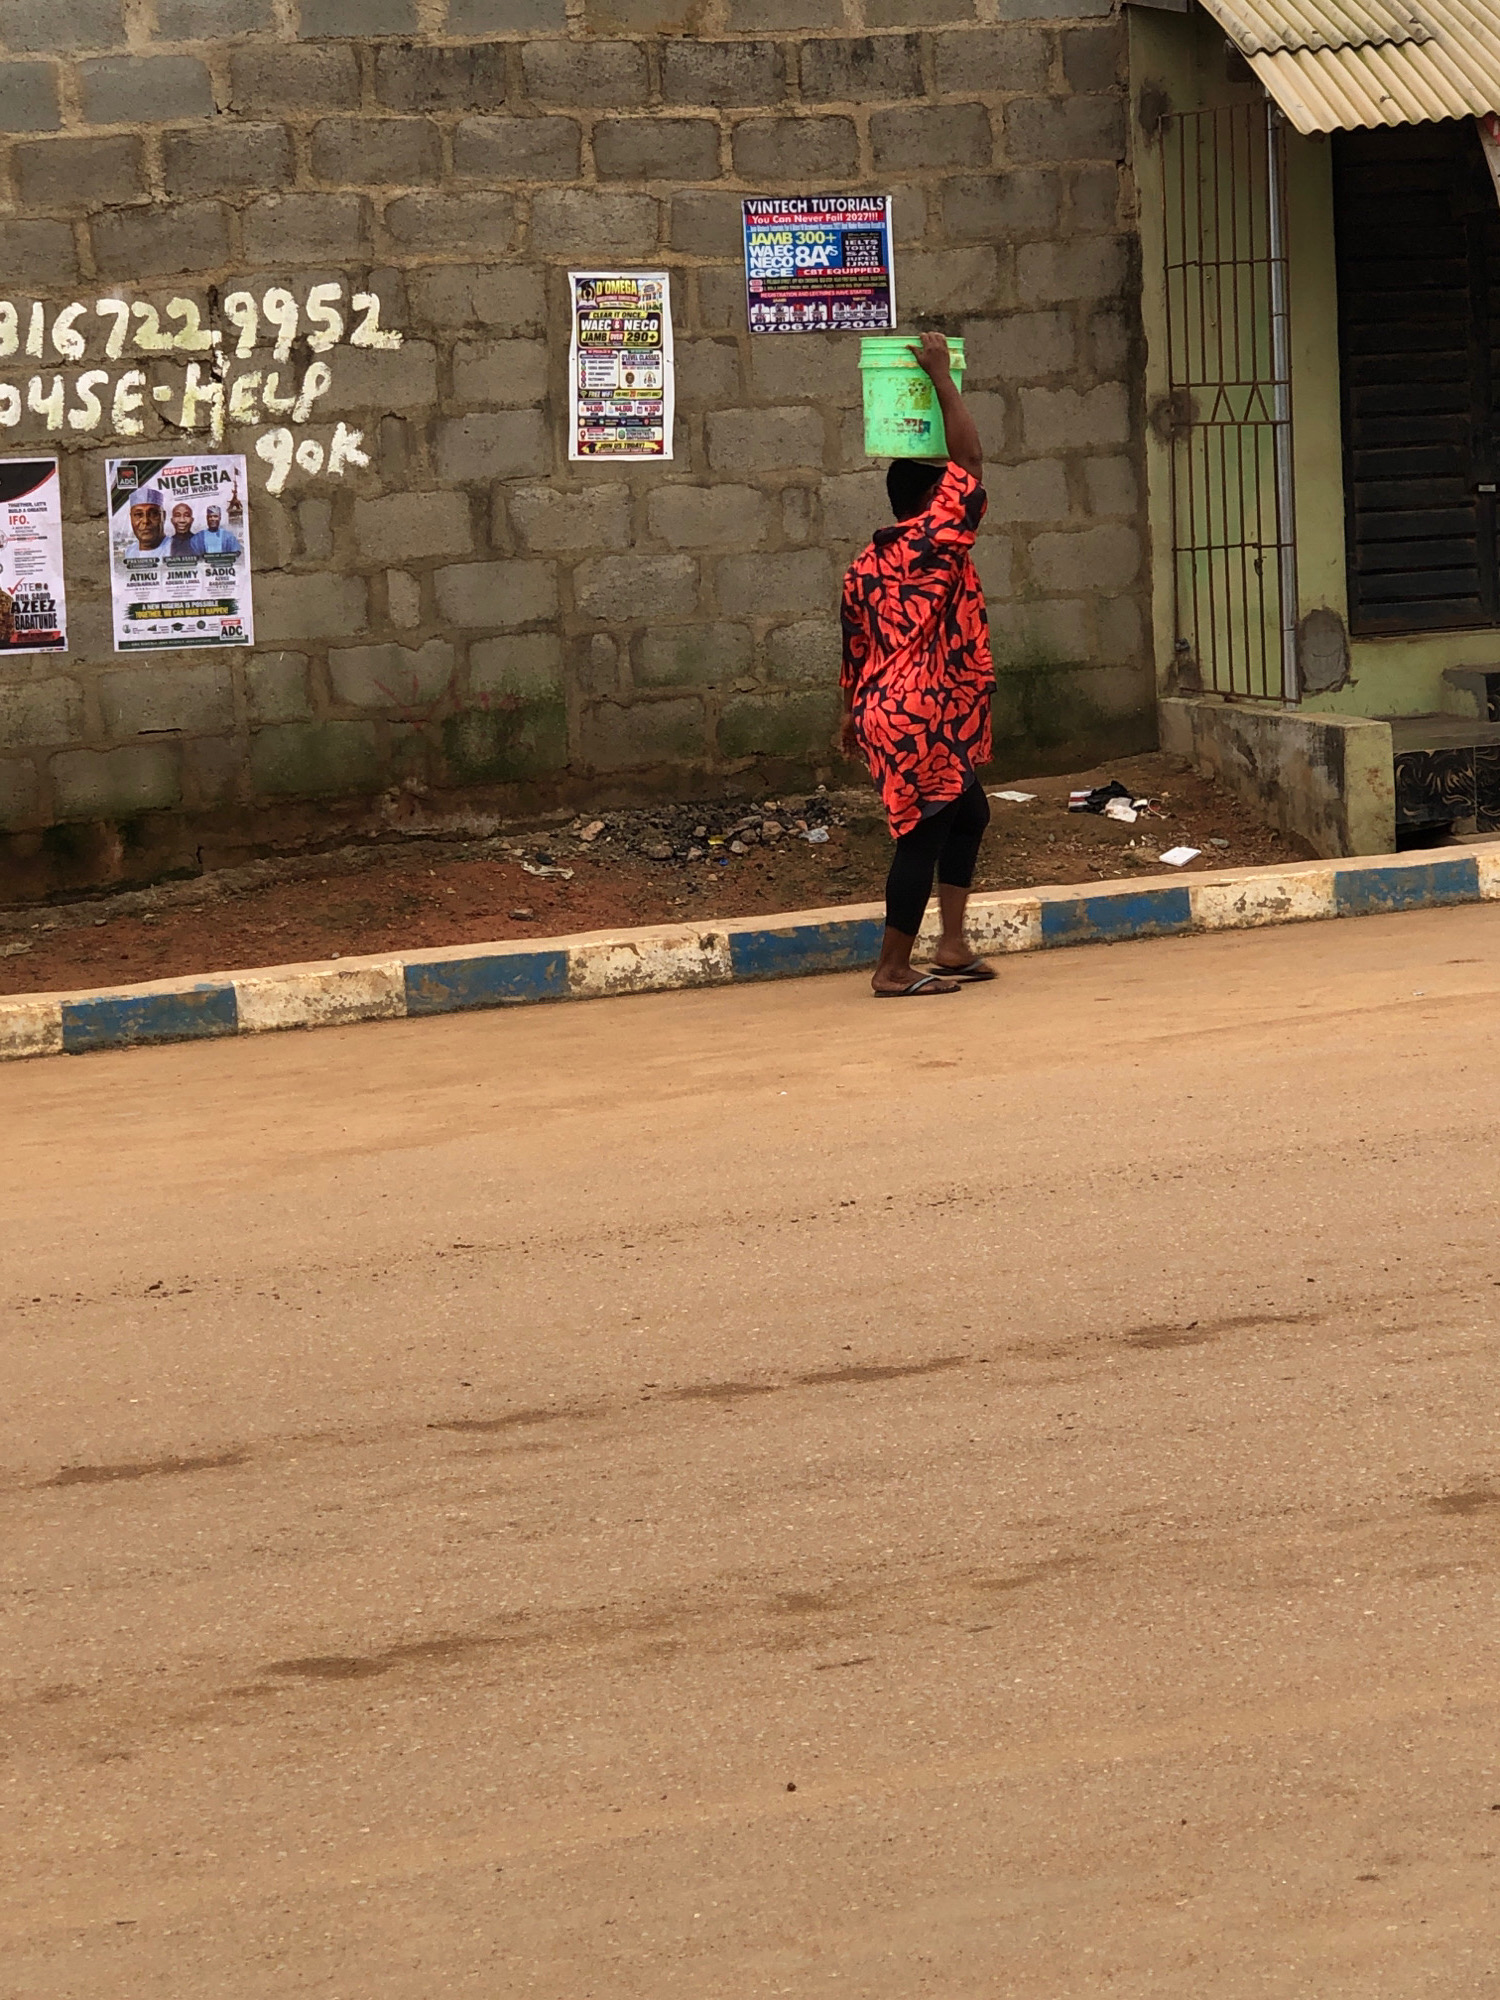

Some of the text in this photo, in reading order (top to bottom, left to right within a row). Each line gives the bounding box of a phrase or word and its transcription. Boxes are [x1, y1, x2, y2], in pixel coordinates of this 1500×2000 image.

[747, 197, 884, 214] VINTECH TUTORIALS
[752, 212, 879, 224] You Can Never Fail 2027!!!
[748, 232, 793, 246] JAMB
[795, 231, 837, 245] 300+
[749, 245, 794, 257] WAEC
[750, 257, 794, 268] NECO
[750, 268, 794, 278] GCE
[803, 267, 881, 276] CBT EQUIPPED
[596, 279, 638, 295] D'OMEGA
[581, 319, 659, 331] WAEC & NECO
[753, 320, 889, 332] 07067472044
[583, 332, 656, 342] JAMB OVER 290+
[588, 390, 601, 398] FREE
[119, 477, 136, 486] ADC
[157, 470, 232, 490] NIGERIA
[172, 483, 219, 496] THAT WORKS
[9, 515, 30, 525] IFO.
[129, 572, 158, 581] ATIKU
[166, 570, 198, 580] JIMMY
[205, 567, 236, 577] SADIQ
[11, 599, 56, 614] AZEEZ
[15, 612, 57, 630] BABATUNDE
[221, 625, 243, 637] ADC
